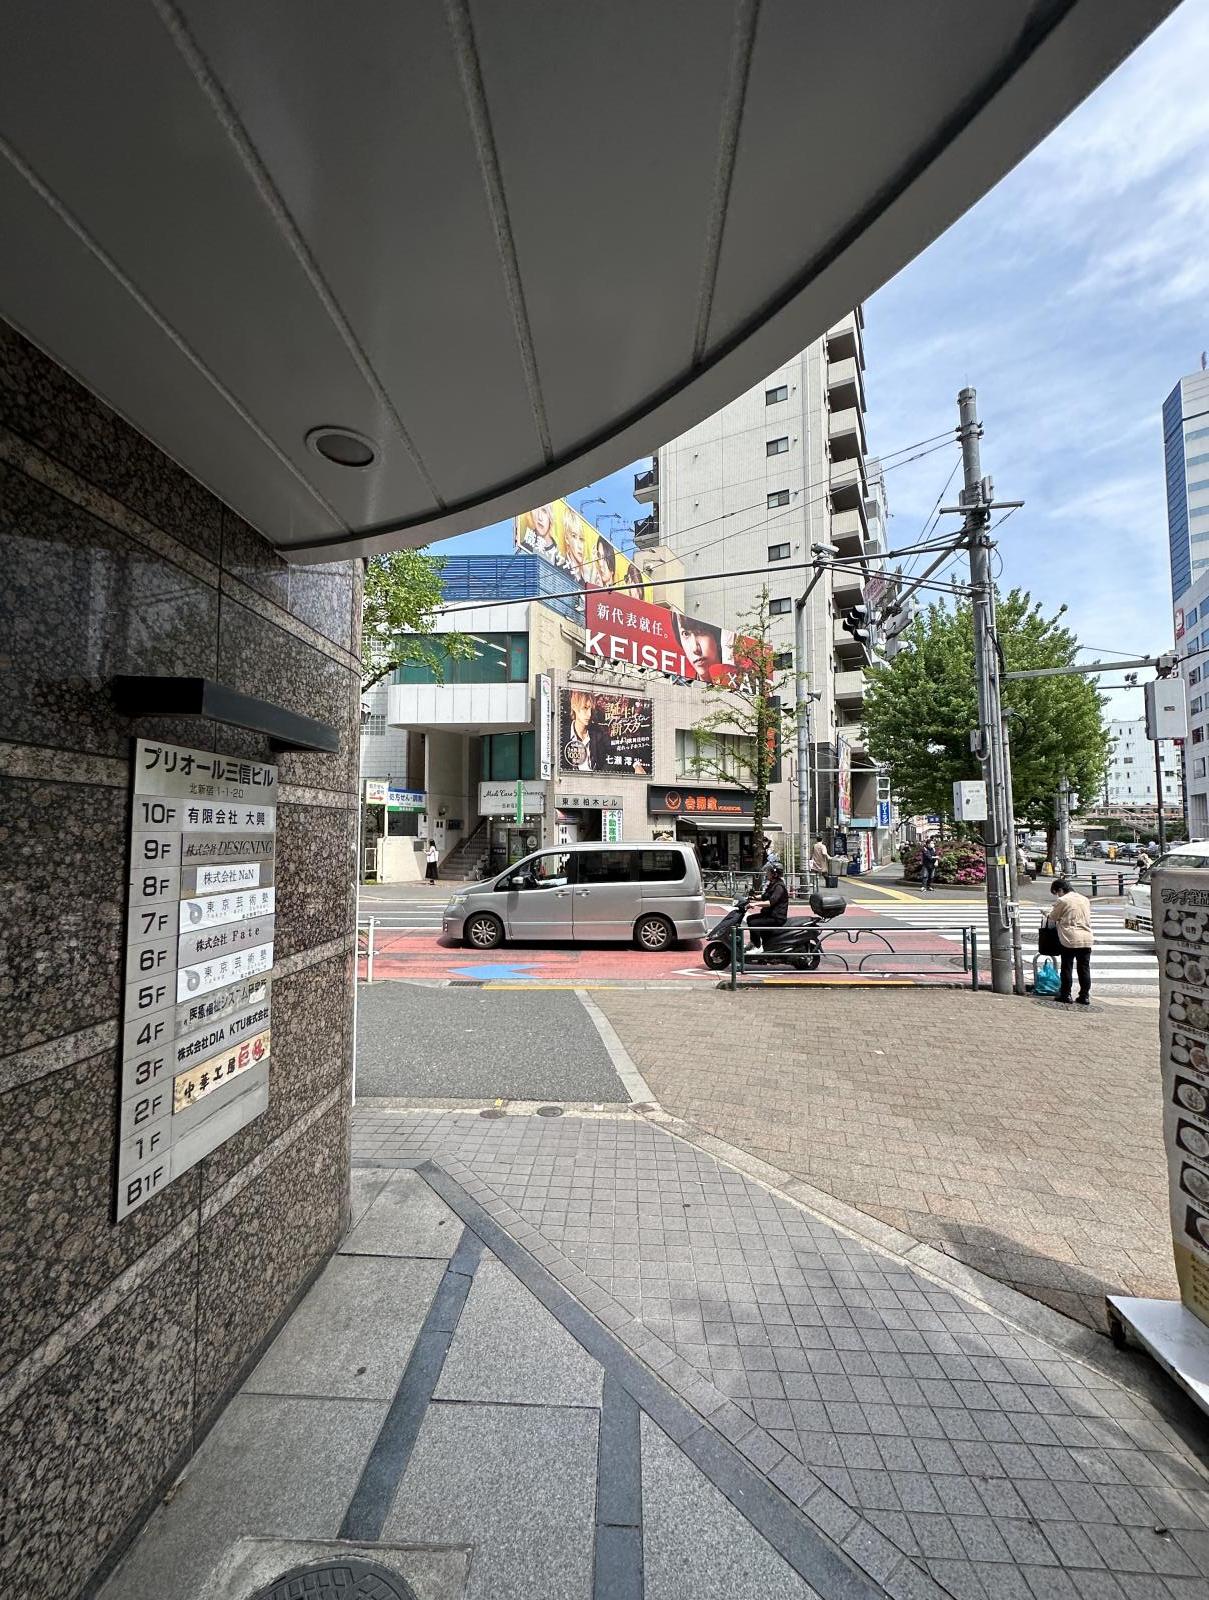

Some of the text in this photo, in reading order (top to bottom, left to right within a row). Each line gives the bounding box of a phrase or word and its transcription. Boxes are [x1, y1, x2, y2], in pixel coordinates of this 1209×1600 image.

[597, 603, 669, 639] 新代表就任。
[585, 628, 686, 677] KEISEI
[144, 747, 274, 788] プリオール三信ビル
[141, 802, 176, 823] 10F
[188, 807, 238, 825] 有限会社
[562, 797, 618, 806] 東京柏木ビル
[144, 839, 171, 860] 9F
[143, 876, 170, 896] 8F
[141, 912, 168, 934] 7F
[140, 927, 260, 971] 6F 株式会社 Fate
[138, 985, 166, 1009] 5F
[136, 1021, 165, 1046] 4F
[135, 1058, 164, 1086] 3F
[134, 1095, 163, 1125] 2F
[135, 1131, 161, 1159] 1F
[127, 1166, 164, 1206] B1F
